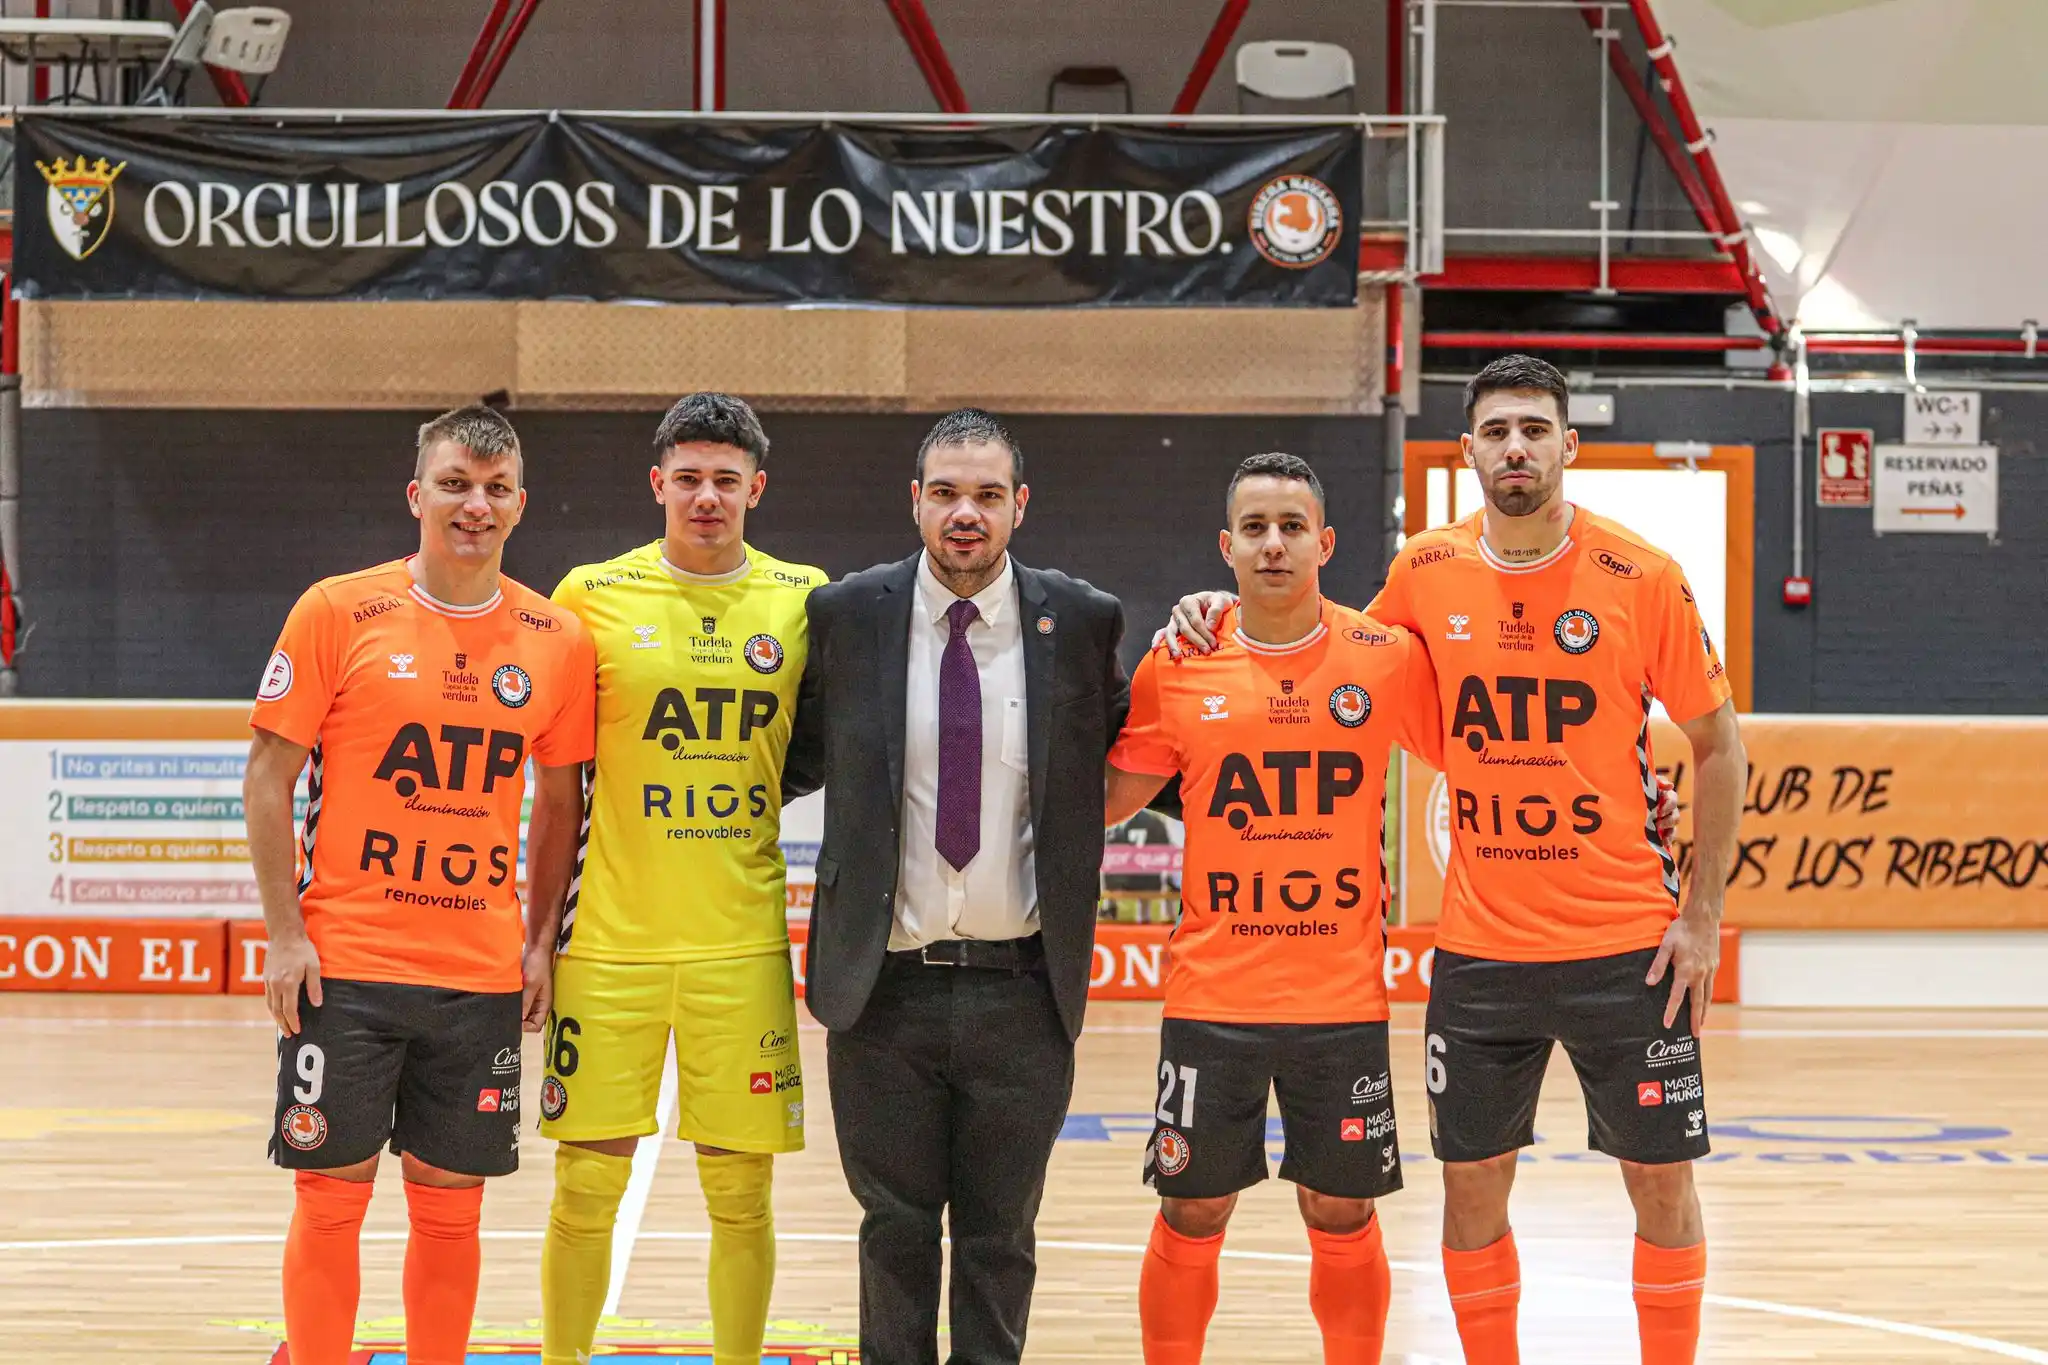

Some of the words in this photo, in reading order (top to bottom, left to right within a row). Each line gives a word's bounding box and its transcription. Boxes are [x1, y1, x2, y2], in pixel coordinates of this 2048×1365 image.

[144, 180, 618, 249] ORGULLOSOS
[645, 183, 740, 251] DE
[769, 186, 862, 253] LO
[890, 188, 1233, 257] NUESTRO.
[1913, 396, 1970, 415] WC-1
[1884, 455, 1988, 472] RESERVADO
[1907, 479, 1965, 497] PEÑAS
[353, 598, 404, 623] BARRAL
[1498, 620, 1535, 634] Tudela
[689, 635, 732, 648] Tudela
[1498, 640, 1534, 652] verdura
[690, 653, 733, 664] verdura
[442, 670, 479, 685] Tudela
[442, 690, 478, 703] verdura
[1267, 696, 1310, 708] Tudela
[642, 687, 780, 750] ATP
[1268, 714, 1311, 724] verdura
[1451, 674, 1597, 752] ATP
[372, 722, 525, 797] ATP
[672, 746, 750, 763] iluminación
[1478, 748, 1568, 768] iluminación
[67, 758, 95, 774] No
[1207, 750, 1364, 829] ATP
[1828, 765, 1894, 815] DE
[49, 790, 63, 822] 2
[404, 793, 491, 819] iluminación
[643, 783, 767, 818] RÍOS
[1455, 788, 1603, 837] RÍOS
[667, 825, 751, 839] renovables
[1240, 824, 1334, 842] iluminación
[49, 832, 63, 862] 3
[1476, 844, 1579, 861] renovables
[359, 829, 509, 887] RÍOS
[1787, 834, 1875, 892] LOS
[384, 885, 487, 911] renovables
[1206, 867, 1362, 913] RÍOS
[1231, 919, 1339, 937] renovables
[139, 938, 211, 982] EL
[1646, 1040, 1694, 1059] Cirsus
[1425, 1033, 1447, 1094] 6
[293, 1043, 325, 1105] 9
[1664, 1073, 1700, 1091] MATEO
[1156, 1060, 1198, 1128] 21
[1665, 1085, 1703, 1104] MUÑOZ
